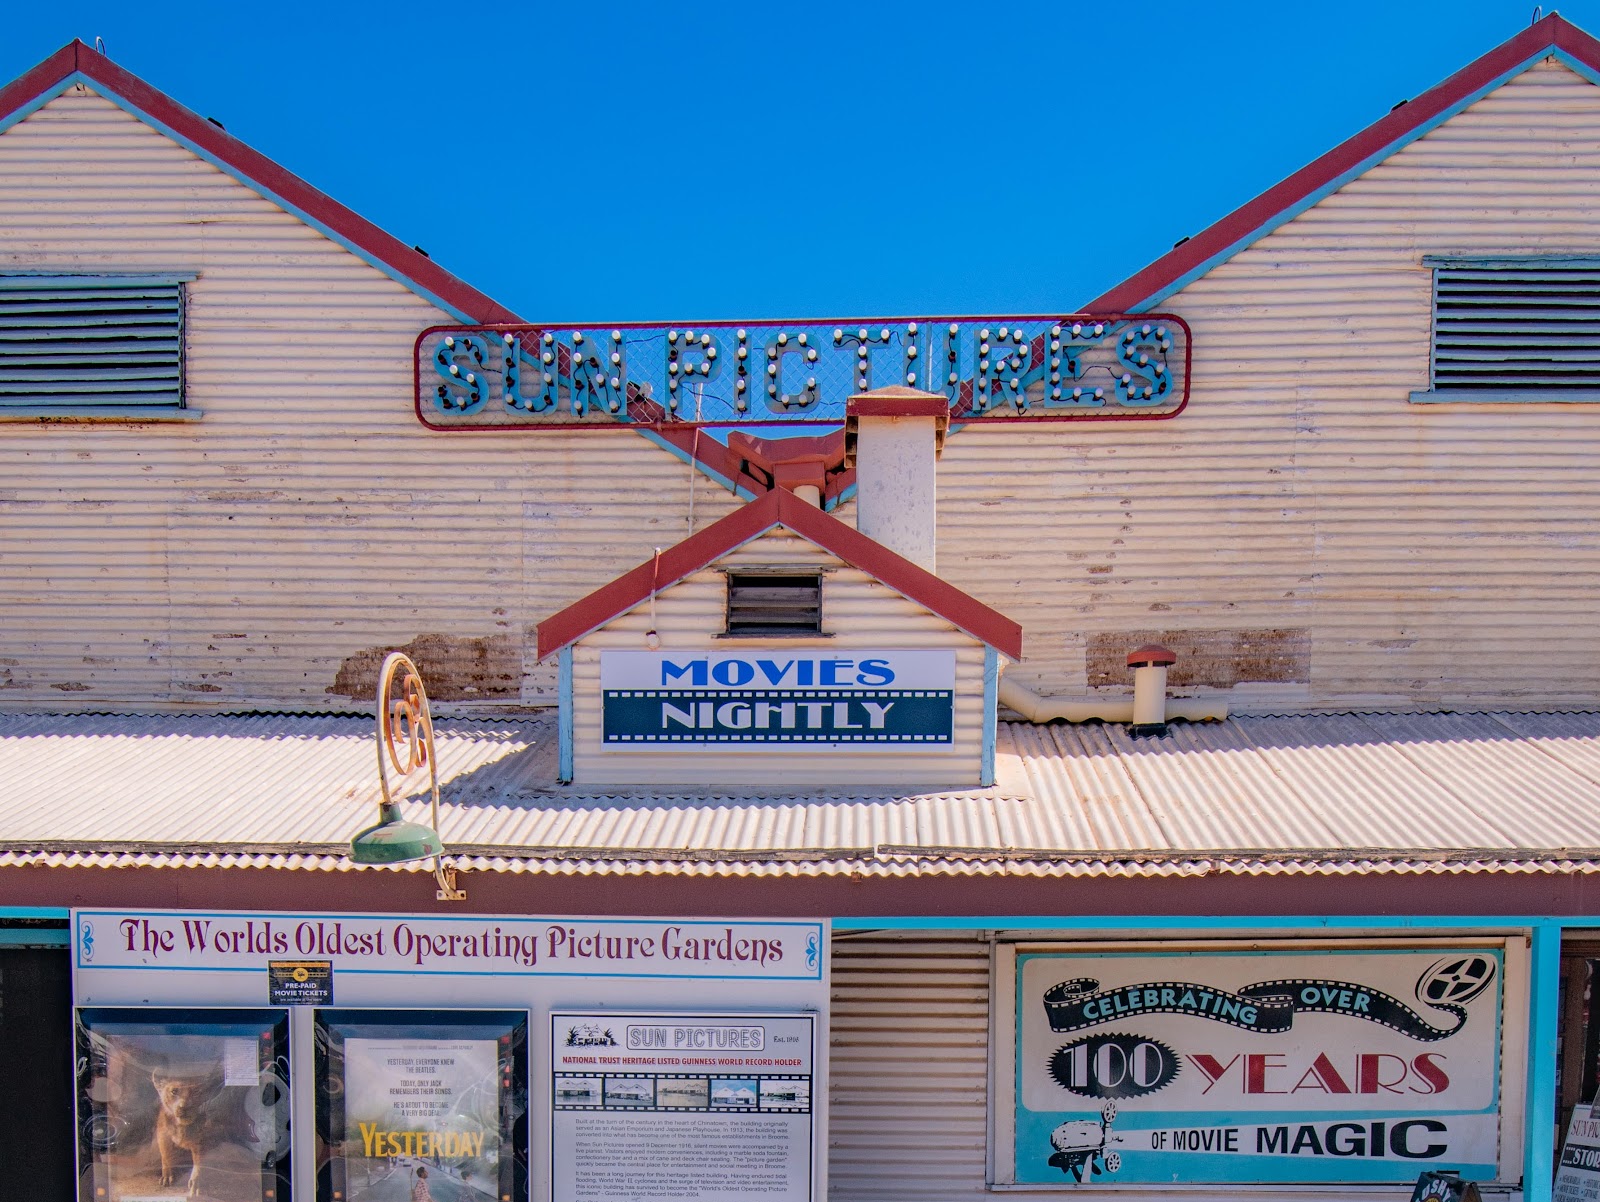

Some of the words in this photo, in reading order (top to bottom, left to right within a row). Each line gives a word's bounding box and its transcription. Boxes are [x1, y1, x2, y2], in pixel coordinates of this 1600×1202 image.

[434, 330, 627, 418] SUN
[665, 322, 1174, 417] PICTURES
[662, 660, 895, 686] MOVIES
[662, 702, 895, 729] NIGHTLY
[119, 919, 174, 958] The
[181, 920, 288, 954] Worlds
[296, 922, 387, 957] Oldest
[394, 923, 538, 966] Operating
[545, 925, 655, 960] Picture
[662, 927, 783, 968] Gardens
[1082, 988, 1258, 1025] CELEBRATING
[1301, 987, 1370, 1012] OVER
[630, 1029, 666, 1047] SUN
[674, 1029, 761, 1048] PICTURES
[622, 1057, 656, 1065] HERITAGE
[658, 1057, 679, 1065] LISTED
[717, 1058, 743, 1066] WORLD
[745, 1058, 772, 1066] RECORD
[774, 1058, 802, 1066] HOLDER
[1063, 1042, 1164, 1087] 100
[1185, 1052, 1450, 1095] YEARS
[359, 1123, 485, 1157] YESTERDAY
[1152, 1131, 1170, 1150] OF
[1173, 1129, 1239, 1153] MOVIE
[1256, 1120, 1447, 1158] MAGIC
[1571, 1120, 1589, 1137] SUN
